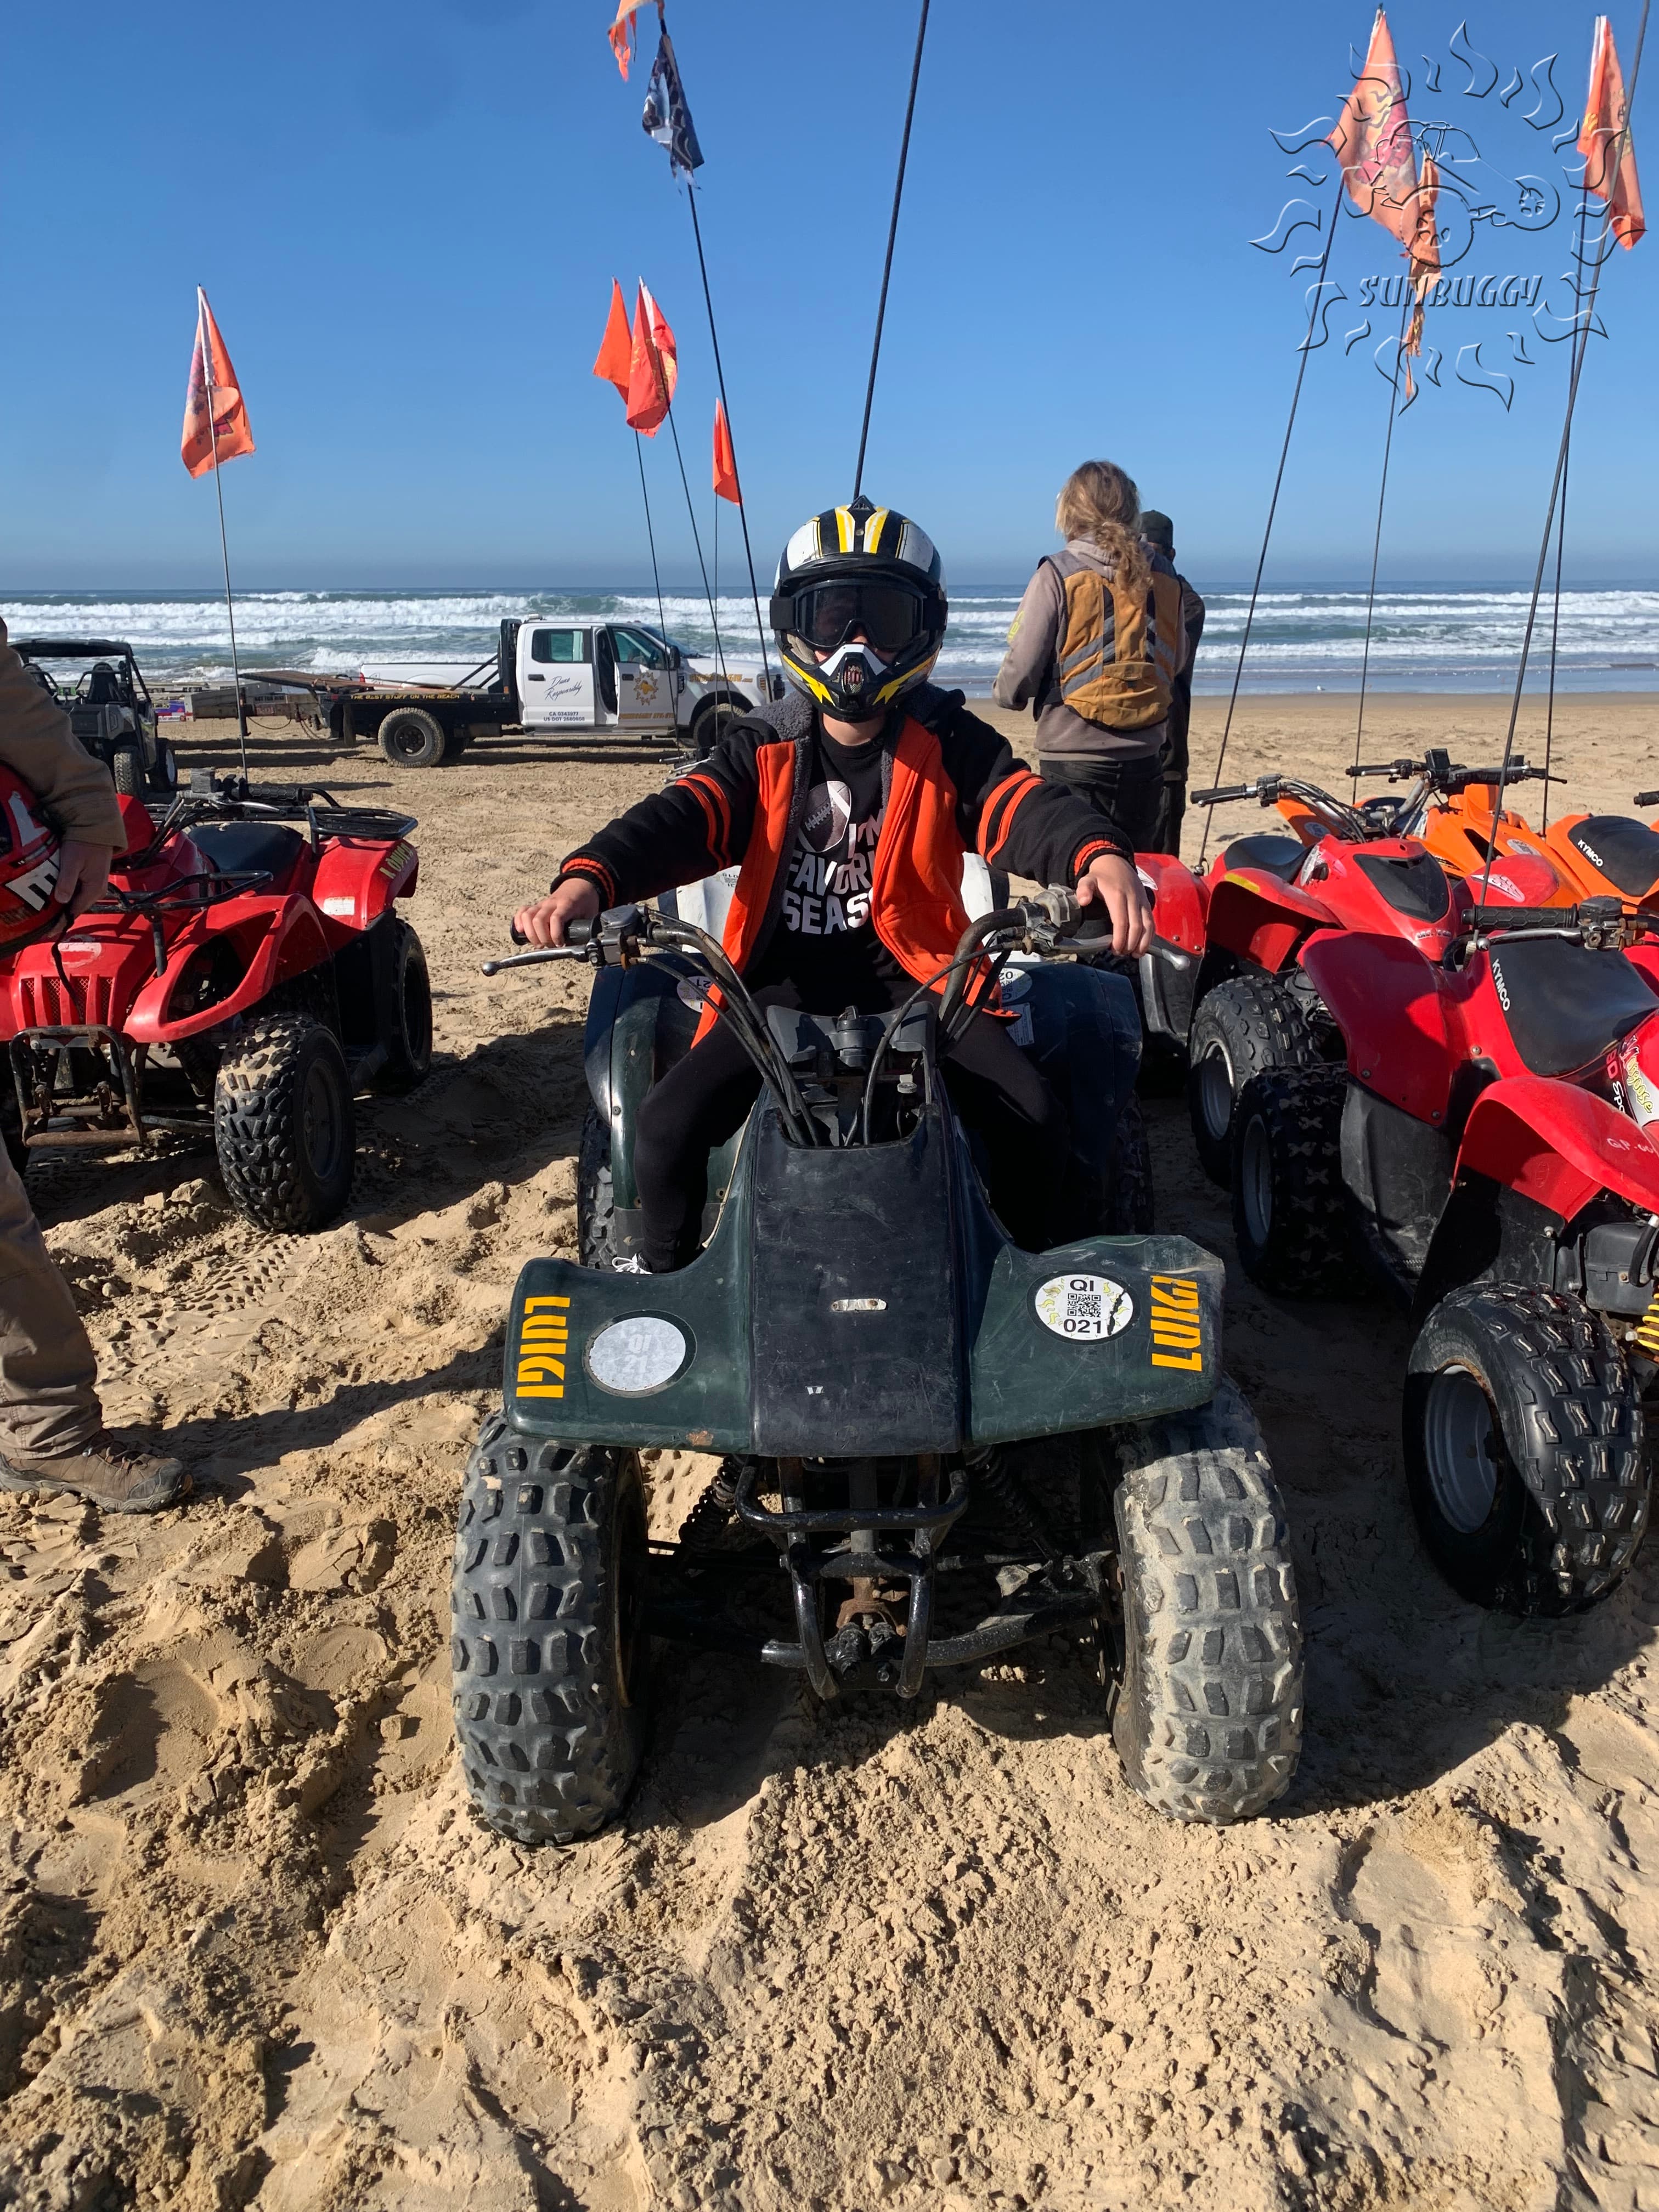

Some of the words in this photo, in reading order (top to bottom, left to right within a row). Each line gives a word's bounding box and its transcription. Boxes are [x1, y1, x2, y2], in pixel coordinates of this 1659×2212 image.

[1577, 839, 1604, 867] KYMCO
[1492, 958, 1510, 1011] KYMCO
[1620, 1034, 1654, 1114] Mongoose
[1070, 1279, 1094, 1292] QI
[516, 1296, 571, 1398] LUIGI
[1063, 1318, 1102, 1334] 021
[1150, 1275, 1203, 1372] LUIGI
